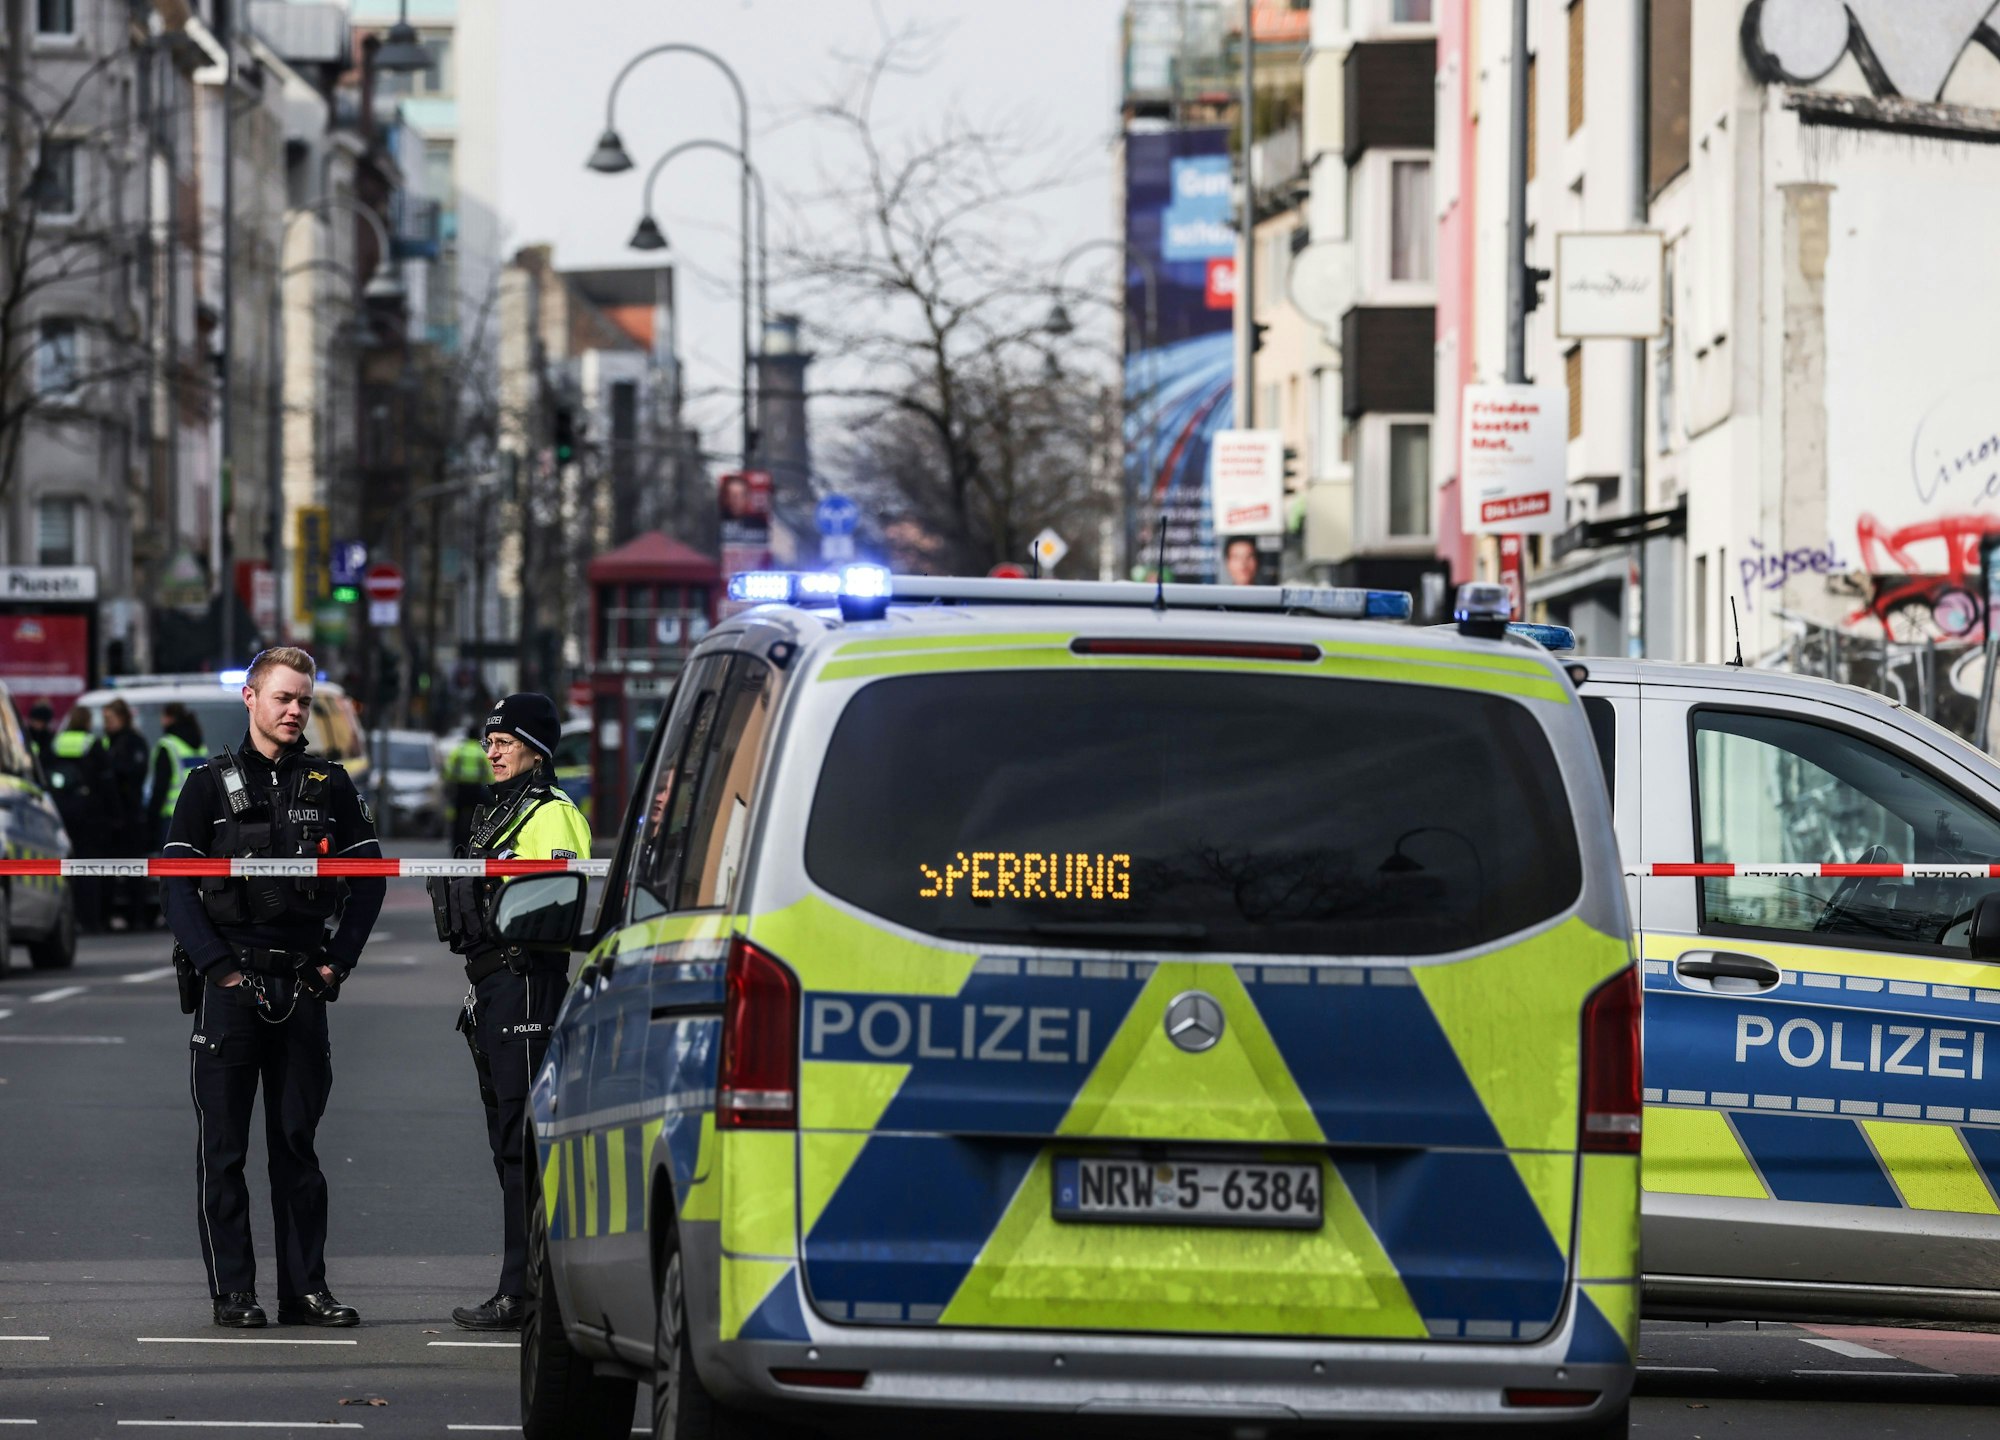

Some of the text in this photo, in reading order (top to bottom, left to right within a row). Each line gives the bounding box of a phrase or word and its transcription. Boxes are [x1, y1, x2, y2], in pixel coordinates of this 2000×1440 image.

[1485, 498, 1546, 519] Die Linke
[513, 1023, 542, 1034] POLIZEI
[811, 999, 1091, 1064] POLIZEI
[1735, 1014, 1985, 1080] POLIZEI
[1080, 1164, 1154, 1208] NRW
[1176, 1166, 1318, 1214] 5-6384
